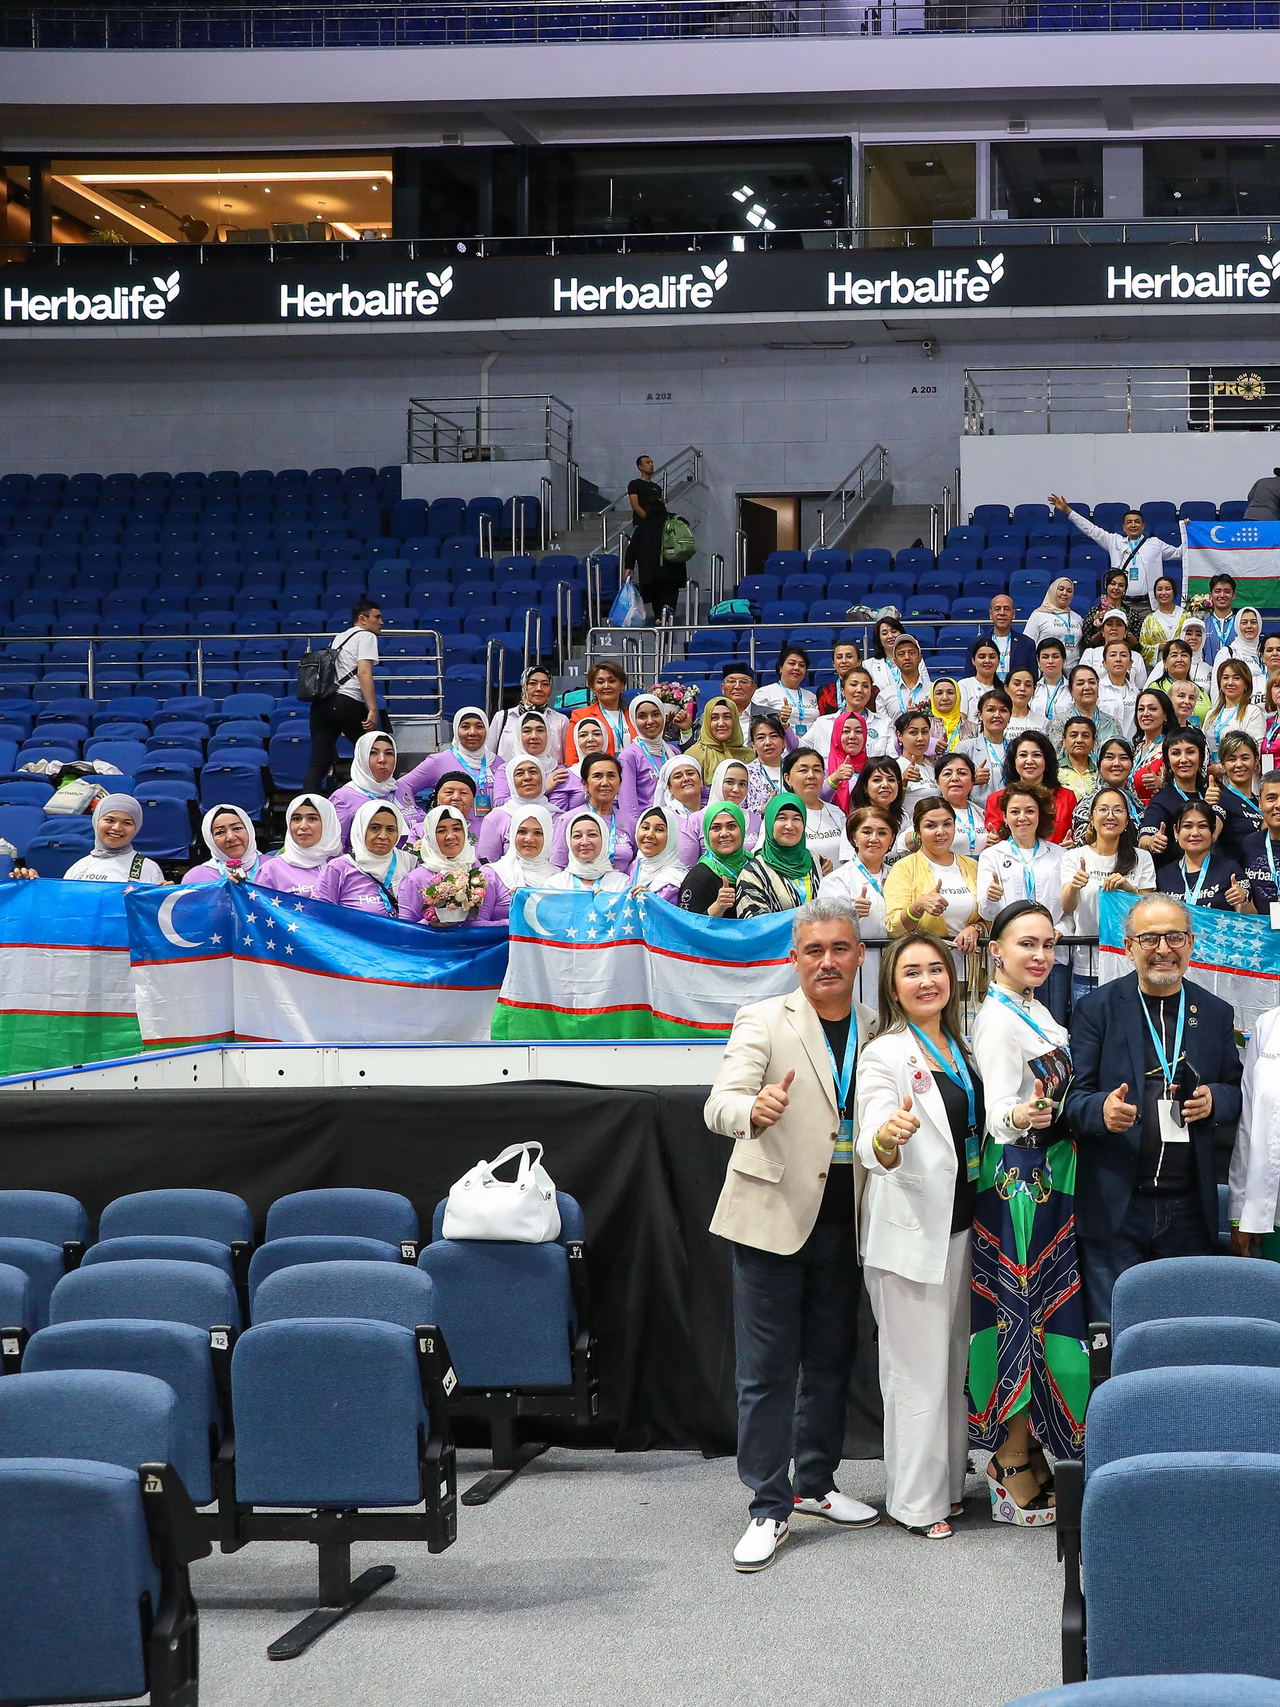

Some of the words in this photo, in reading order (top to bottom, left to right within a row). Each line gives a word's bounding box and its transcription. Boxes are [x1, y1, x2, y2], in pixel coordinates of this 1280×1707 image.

[829, 268, 990, 305] Herbalife
[1108, 264, 1270, 299] Herbalife
[553, 274, 710, 313] Herbalife
[4, 286, 166, 321] Herbalife
[281, 281, 438, 317] Herbalife
[911, 386, 919, 394] A
[920, 386, 938, 394] 203
[646, 392, 654, 400] A
[655, 392, 672, 400] 202
[600, 637, 612, 646] 12
[568, 666, 579, 676] 11
[85, 873, 107, 881] YOUR
[939, 884, 970, 895] erbalif
[215, 1338, 225, 1346] 12
[145, 1480, 158, 1490] 17
